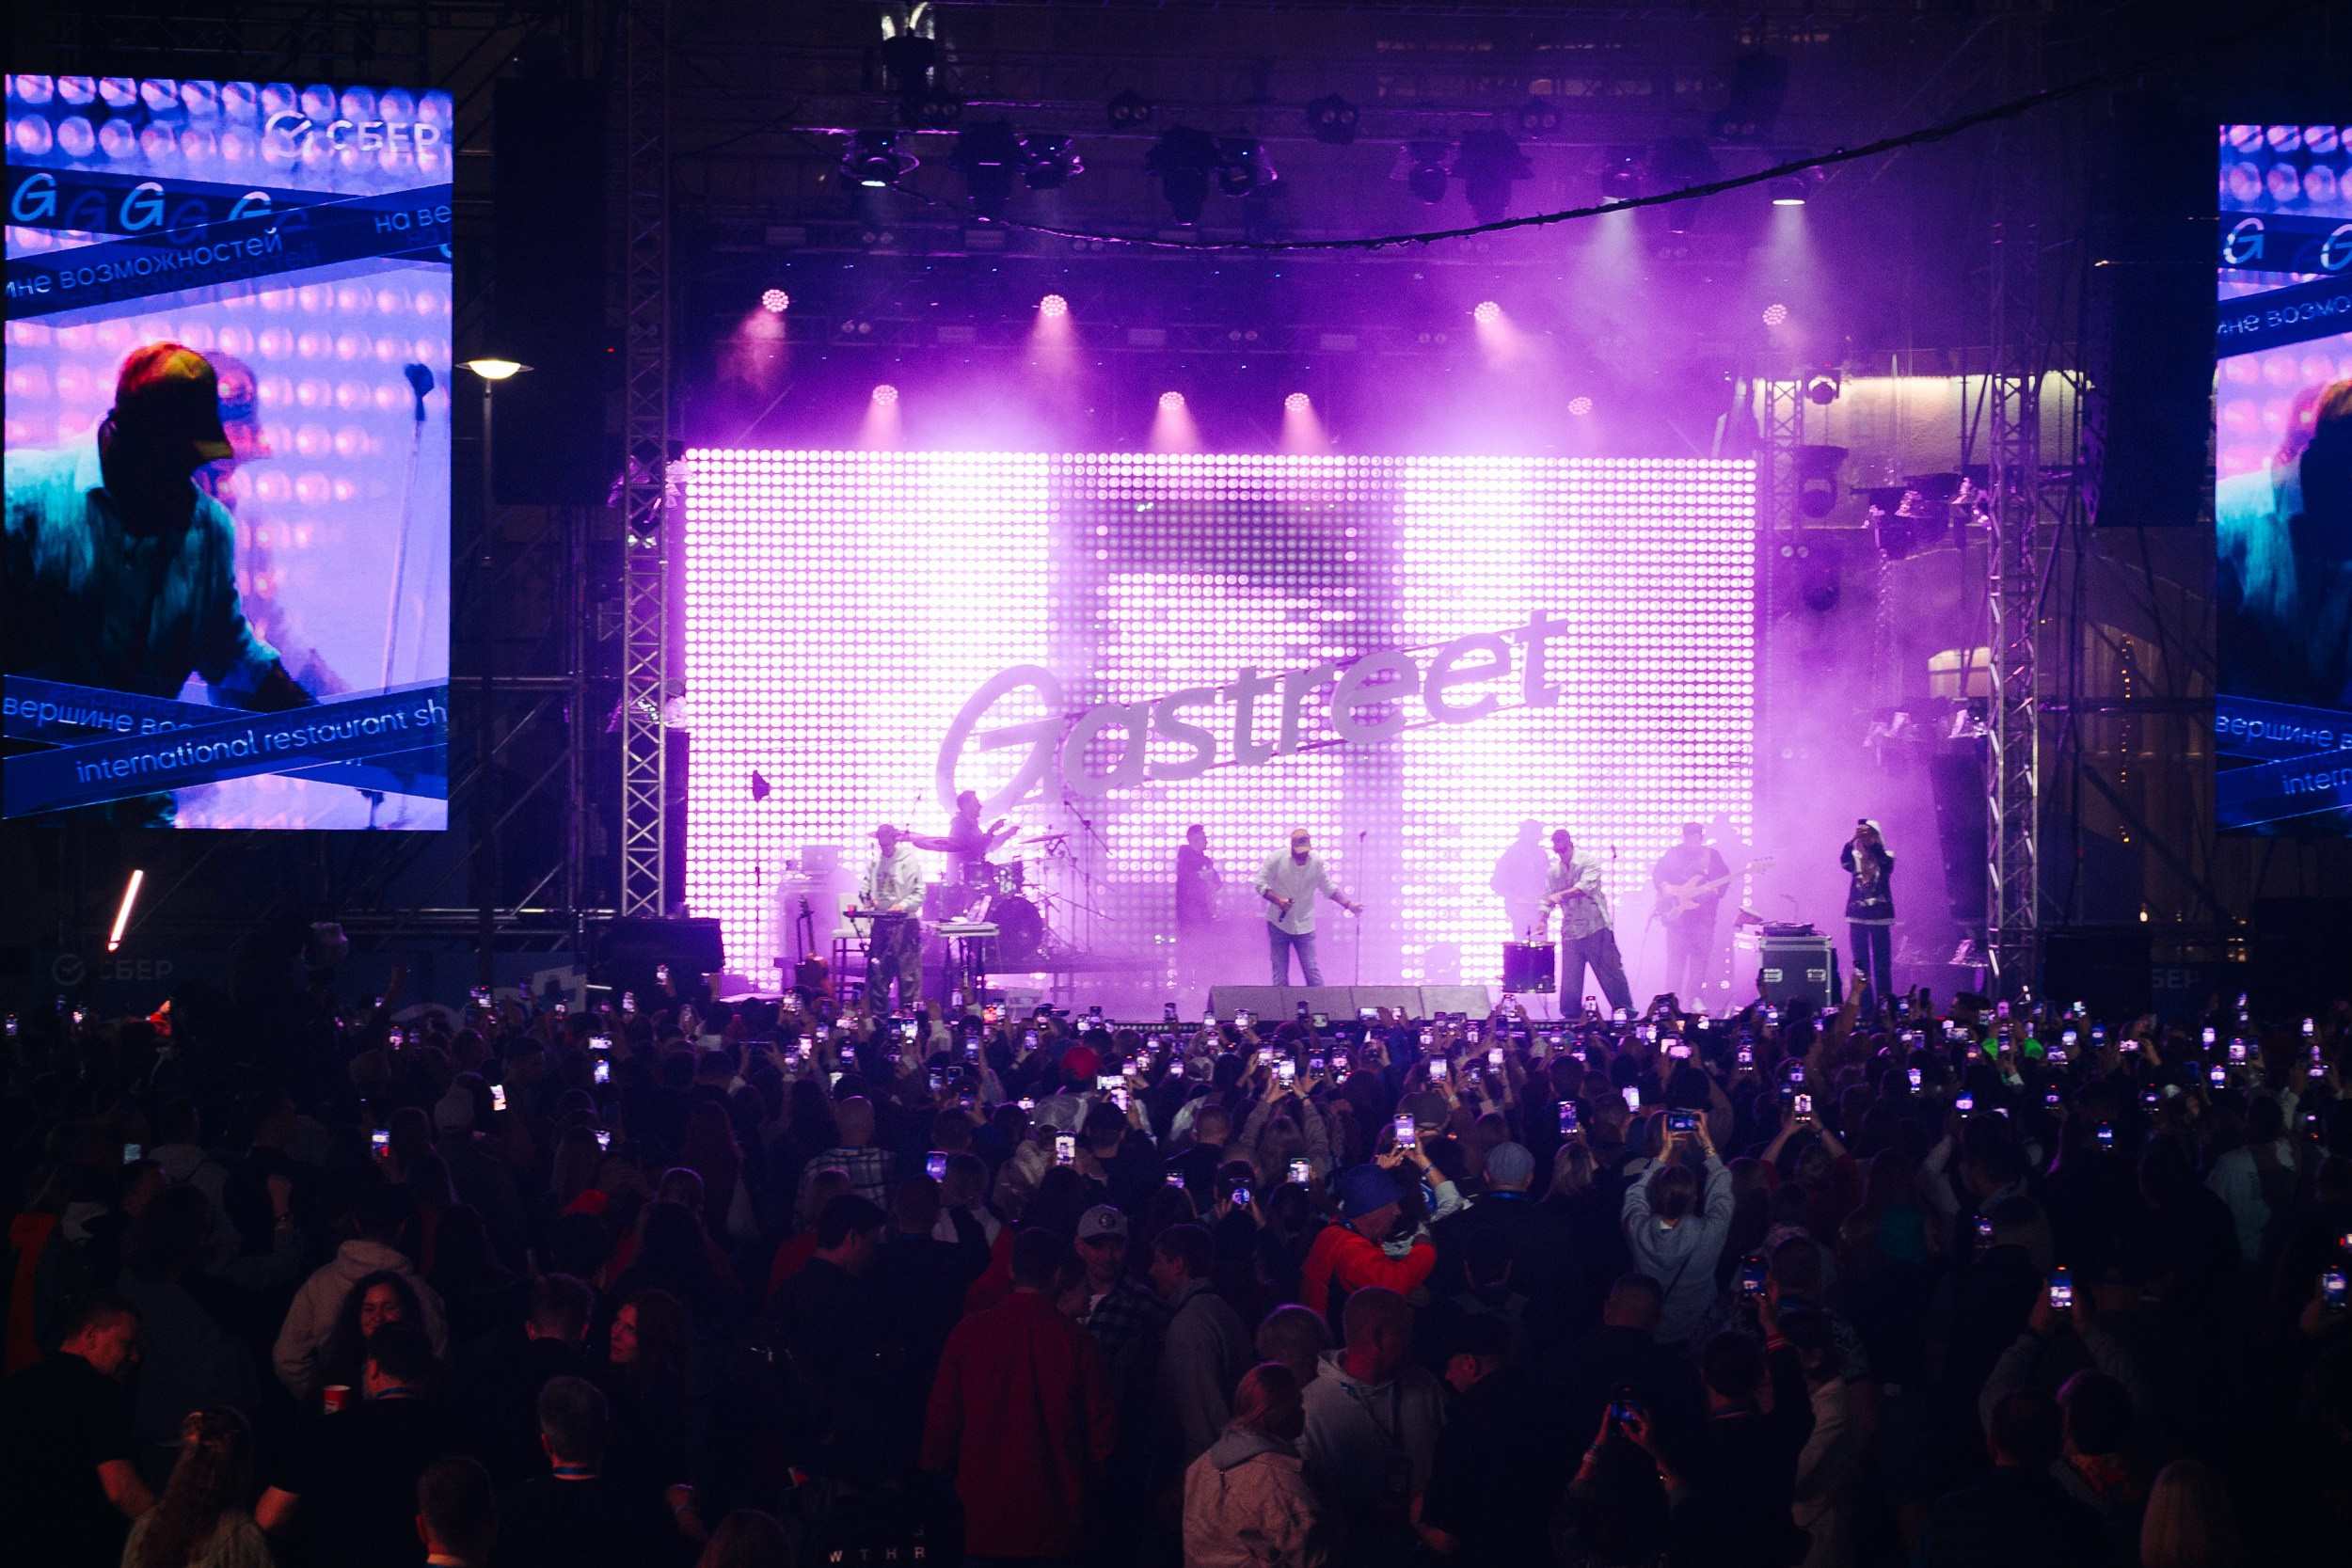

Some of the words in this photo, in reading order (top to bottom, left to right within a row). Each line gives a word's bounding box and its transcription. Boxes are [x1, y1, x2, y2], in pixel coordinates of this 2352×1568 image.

[326, 119, 441, 153] СБЕР
[11, 173, 56, 222] G
[119, 182, 165, 230] G
[59, 227, 283, 289] возможностей
[375, 213, 410, 233] на
[2223, 217, 2265, 264] G
[3, 697, 134, 732] вершине
[935, 610, 1567, 824] Gastreet
[2215, 716, 2333, 747] вершине
[76, 729, 260, 783] international
[264, 712, 408, 752] restaurant
[414, 699, 448, 726] sh
